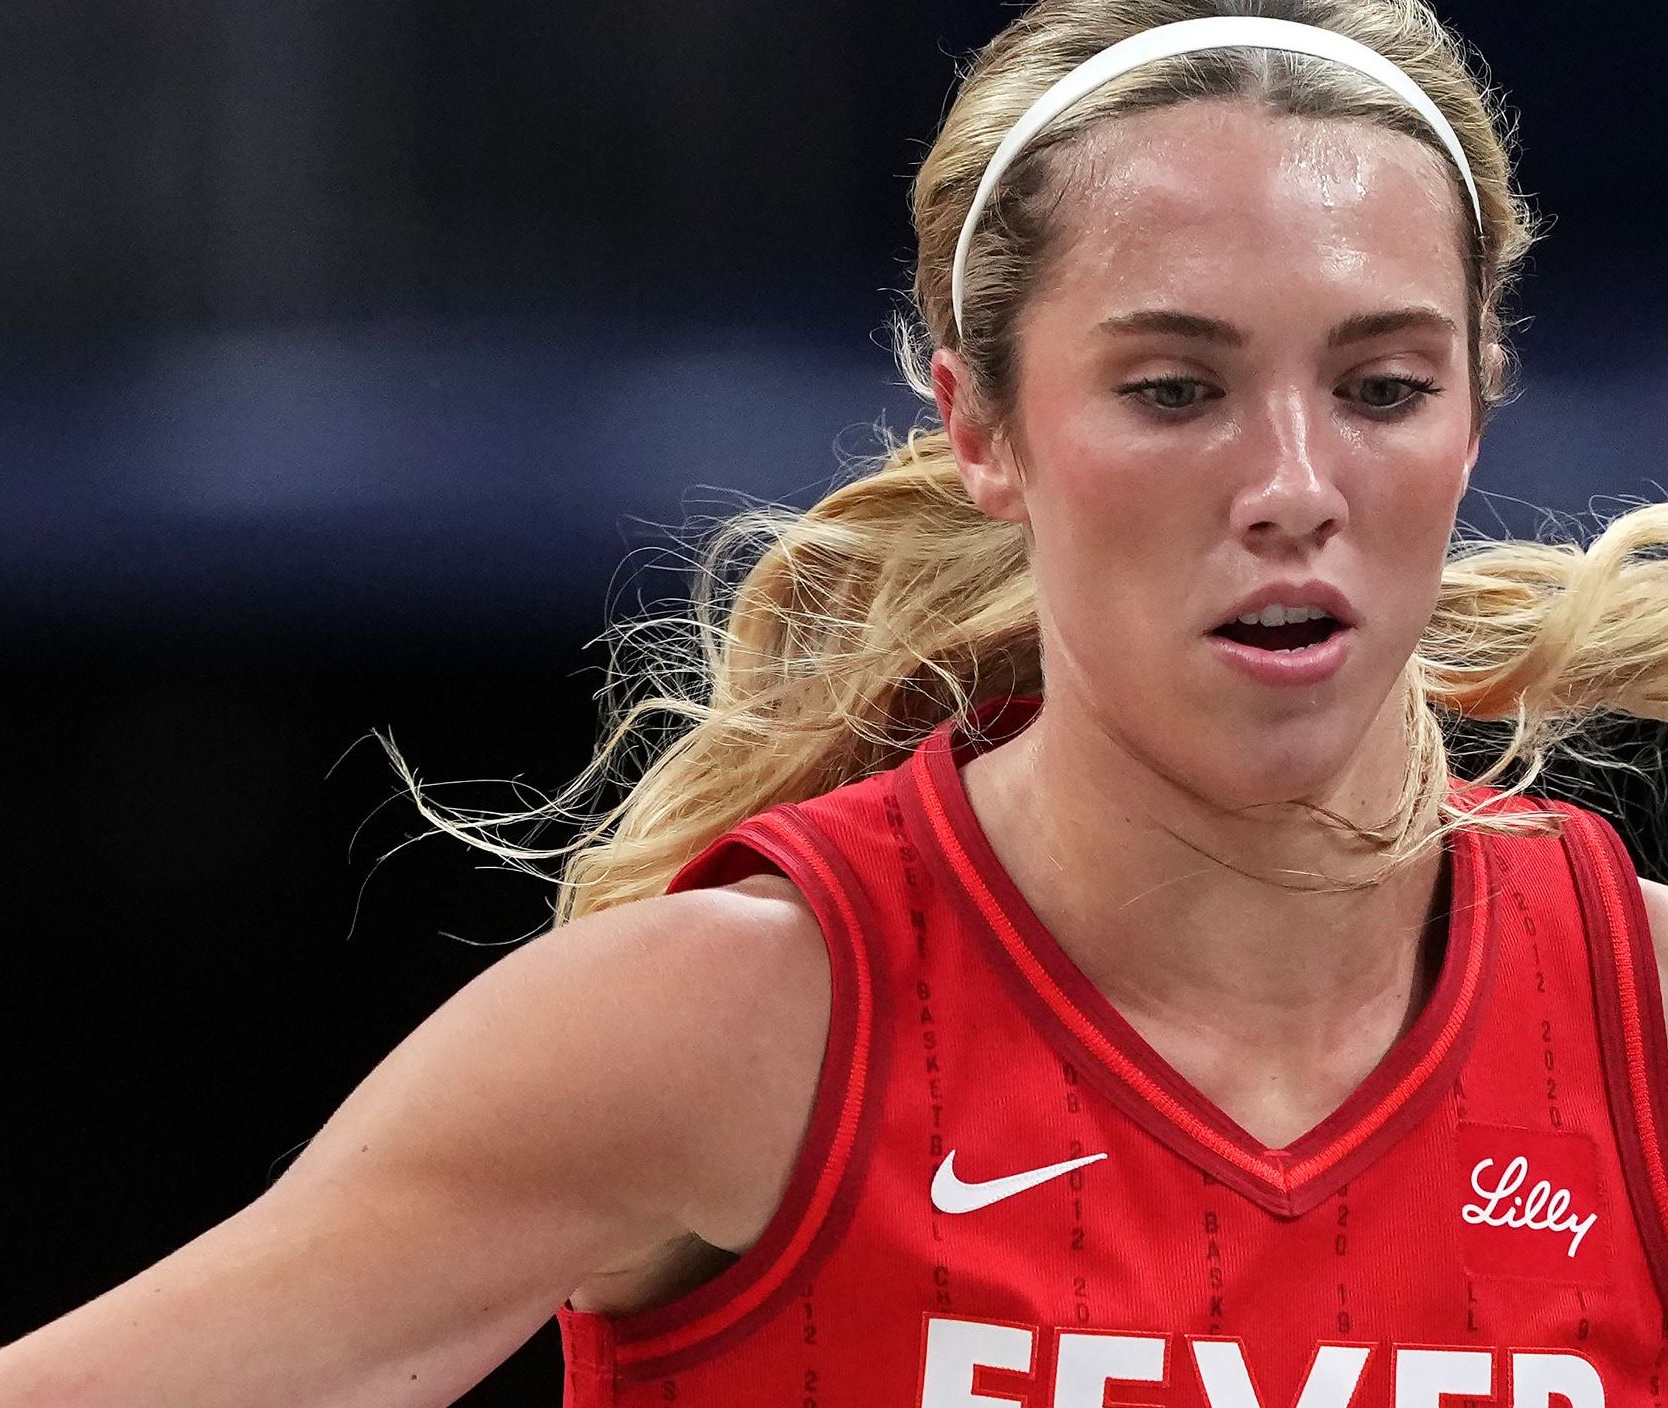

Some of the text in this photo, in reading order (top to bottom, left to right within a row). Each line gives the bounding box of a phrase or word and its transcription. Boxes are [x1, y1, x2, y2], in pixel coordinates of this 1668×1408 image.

[917, 980, 943, 1242] BASKETBL
[1540, 1020, 1561, 1129] 2020
[1462, 1156, 1598, 1258] Lilly
